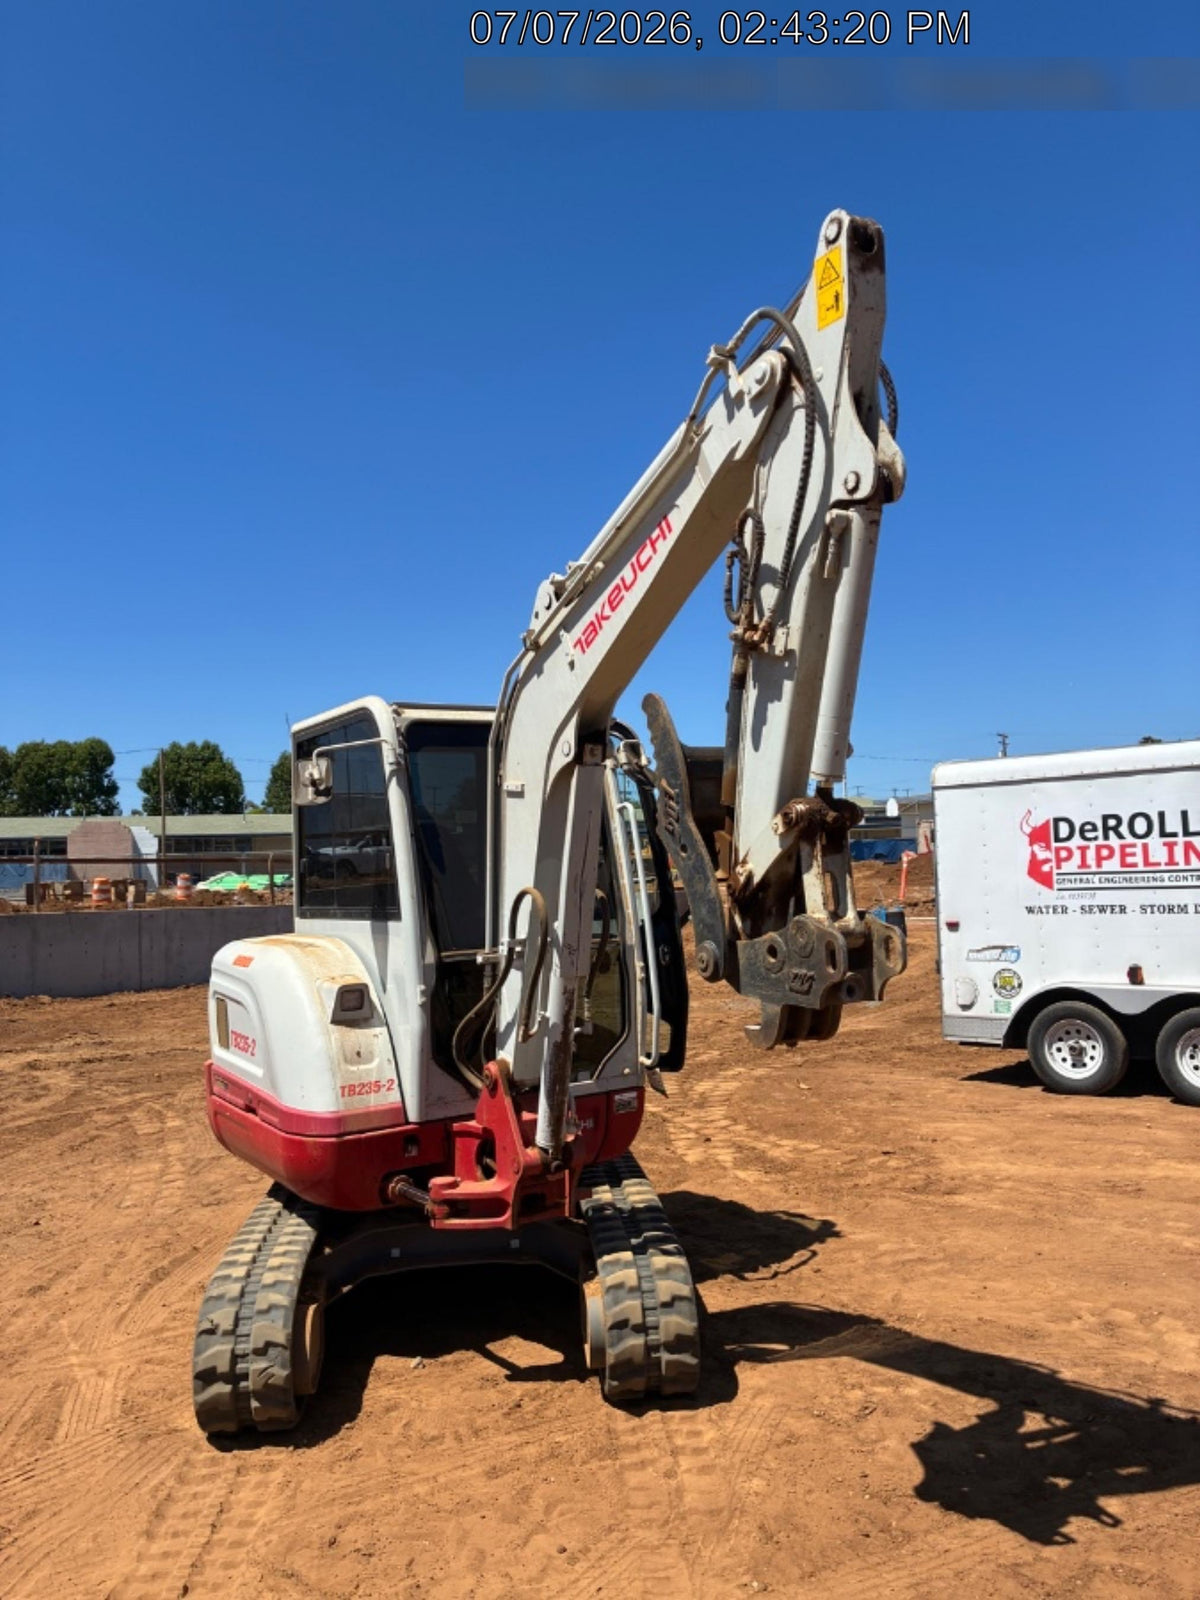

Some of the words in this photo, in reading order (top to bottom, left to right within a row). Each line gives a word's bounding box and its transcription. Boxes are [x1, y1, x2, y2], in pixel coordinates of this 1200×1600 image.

[1052, 809, 1200, 843] DeROLL
[1055, 877, 1097, 886] GENERAL
[1098, 875, 1166, 885] ENGINEERING
[1025, 904, 1069, 915] WATER
[1080, 904, 1128, 915] SEWER
[1139, 903, 1189, 915] STORM
[230, 1029, 257, 1057] TB235-2
[339, 1078, 396, 1098] TB235-2
